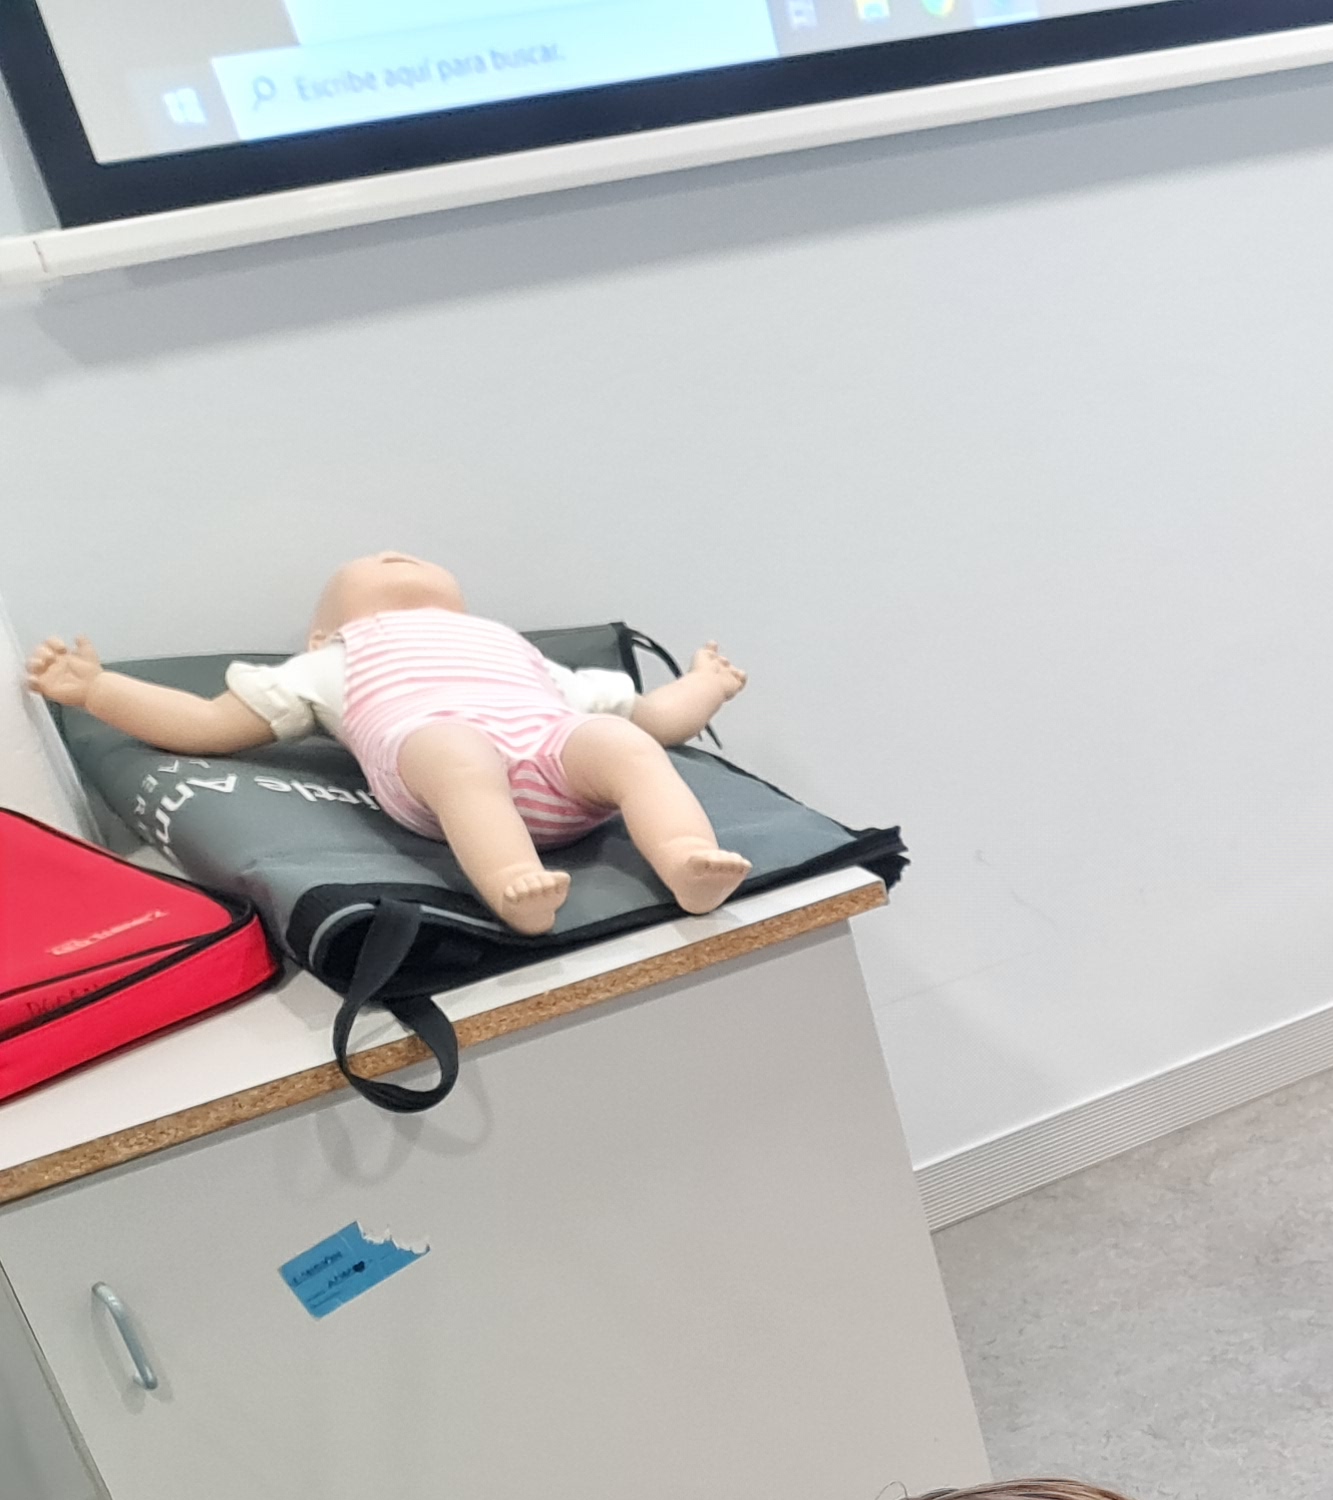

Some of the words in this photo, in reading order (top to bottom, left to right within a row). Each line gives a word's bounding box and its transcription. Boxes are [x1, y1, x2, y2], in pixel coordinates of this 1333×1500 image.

[296, 69, 377, 101] Escribe
[385, 59, 431, 89] aquí
[438, 53, 487, 82] para
[254, 774, 380, 810] ittle
